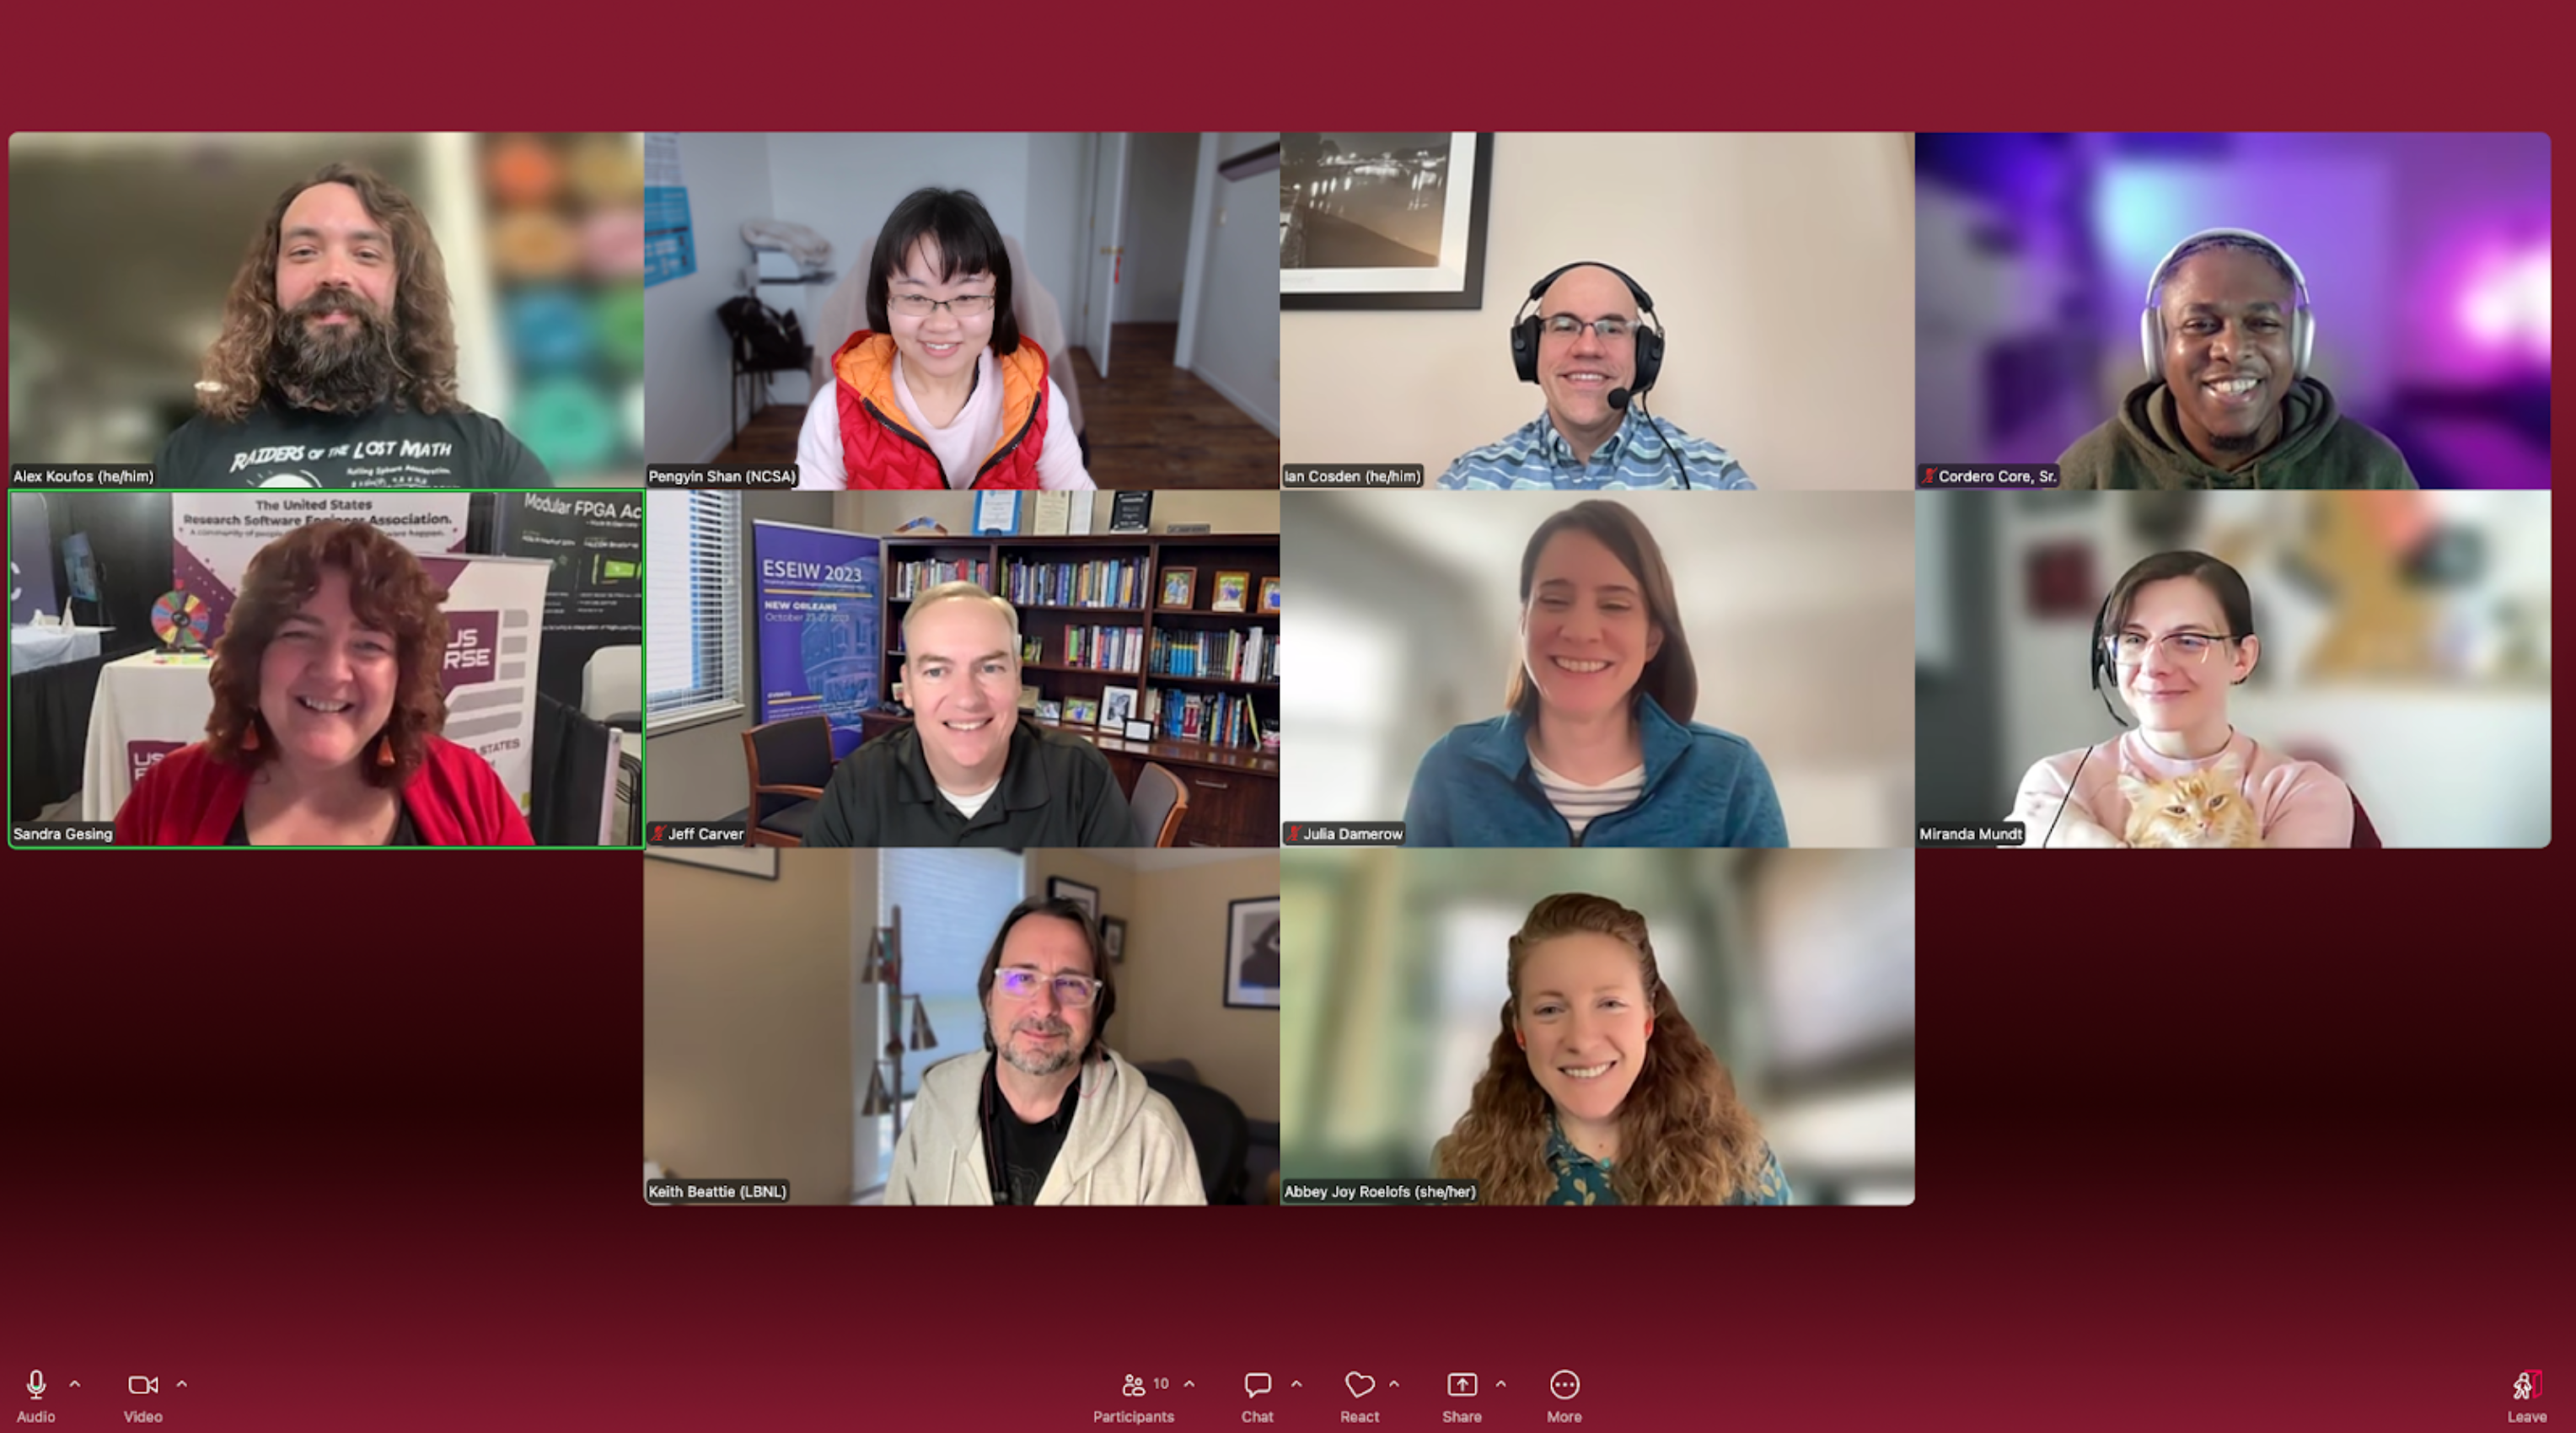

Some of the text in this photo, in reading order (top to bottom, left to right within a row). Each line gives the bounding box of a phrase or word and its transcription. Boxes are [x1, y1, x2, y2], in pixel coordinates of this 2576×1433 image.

[228, 445, 306, 473] RAIDERS
[352, 441, 398, 459] LOST
[400, 438, 452, 459] MATH
[255, 499, 373, 511] The United States
[524, 491, 572, 515] Modular
[574, 500, 616, 518] FPGA
[183, 514, 241, 525] Research
[244, 514, 302, 525] Software
[370, 513, 453, 525] Association.
[763, 559, 862, 582] ESEIW 2023
[764, 600, 837, 612] NEW ORLEANS
[765, 612, 803, 622] October
[443, 648, 491, 670] RSE
[479, 738, 520, 756] STATES
